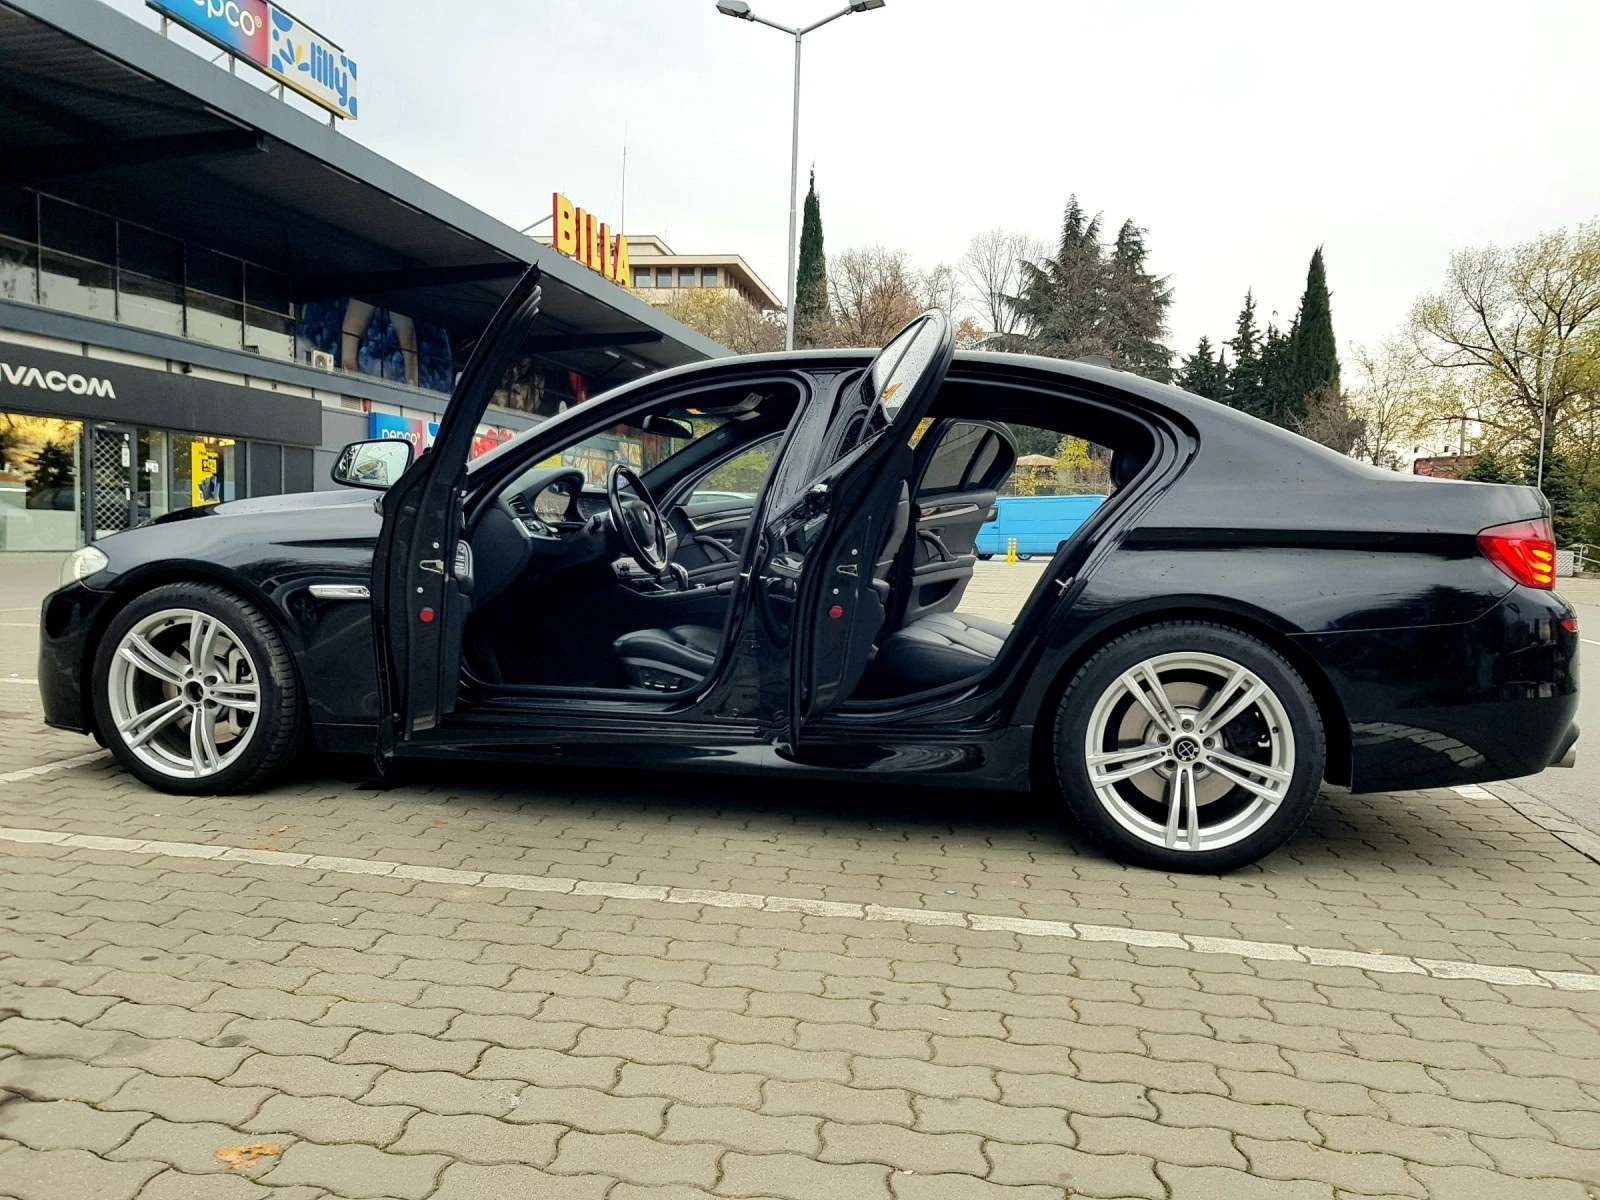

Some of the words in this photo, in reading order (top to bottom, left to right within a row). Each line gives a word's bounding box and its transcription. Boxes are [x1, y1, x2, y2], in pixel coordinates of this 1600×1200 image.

[310, 41, 348, 107] lilly
[552, 191, 632, 289] BILLA
[0, 362, 117, 400] VACOM
